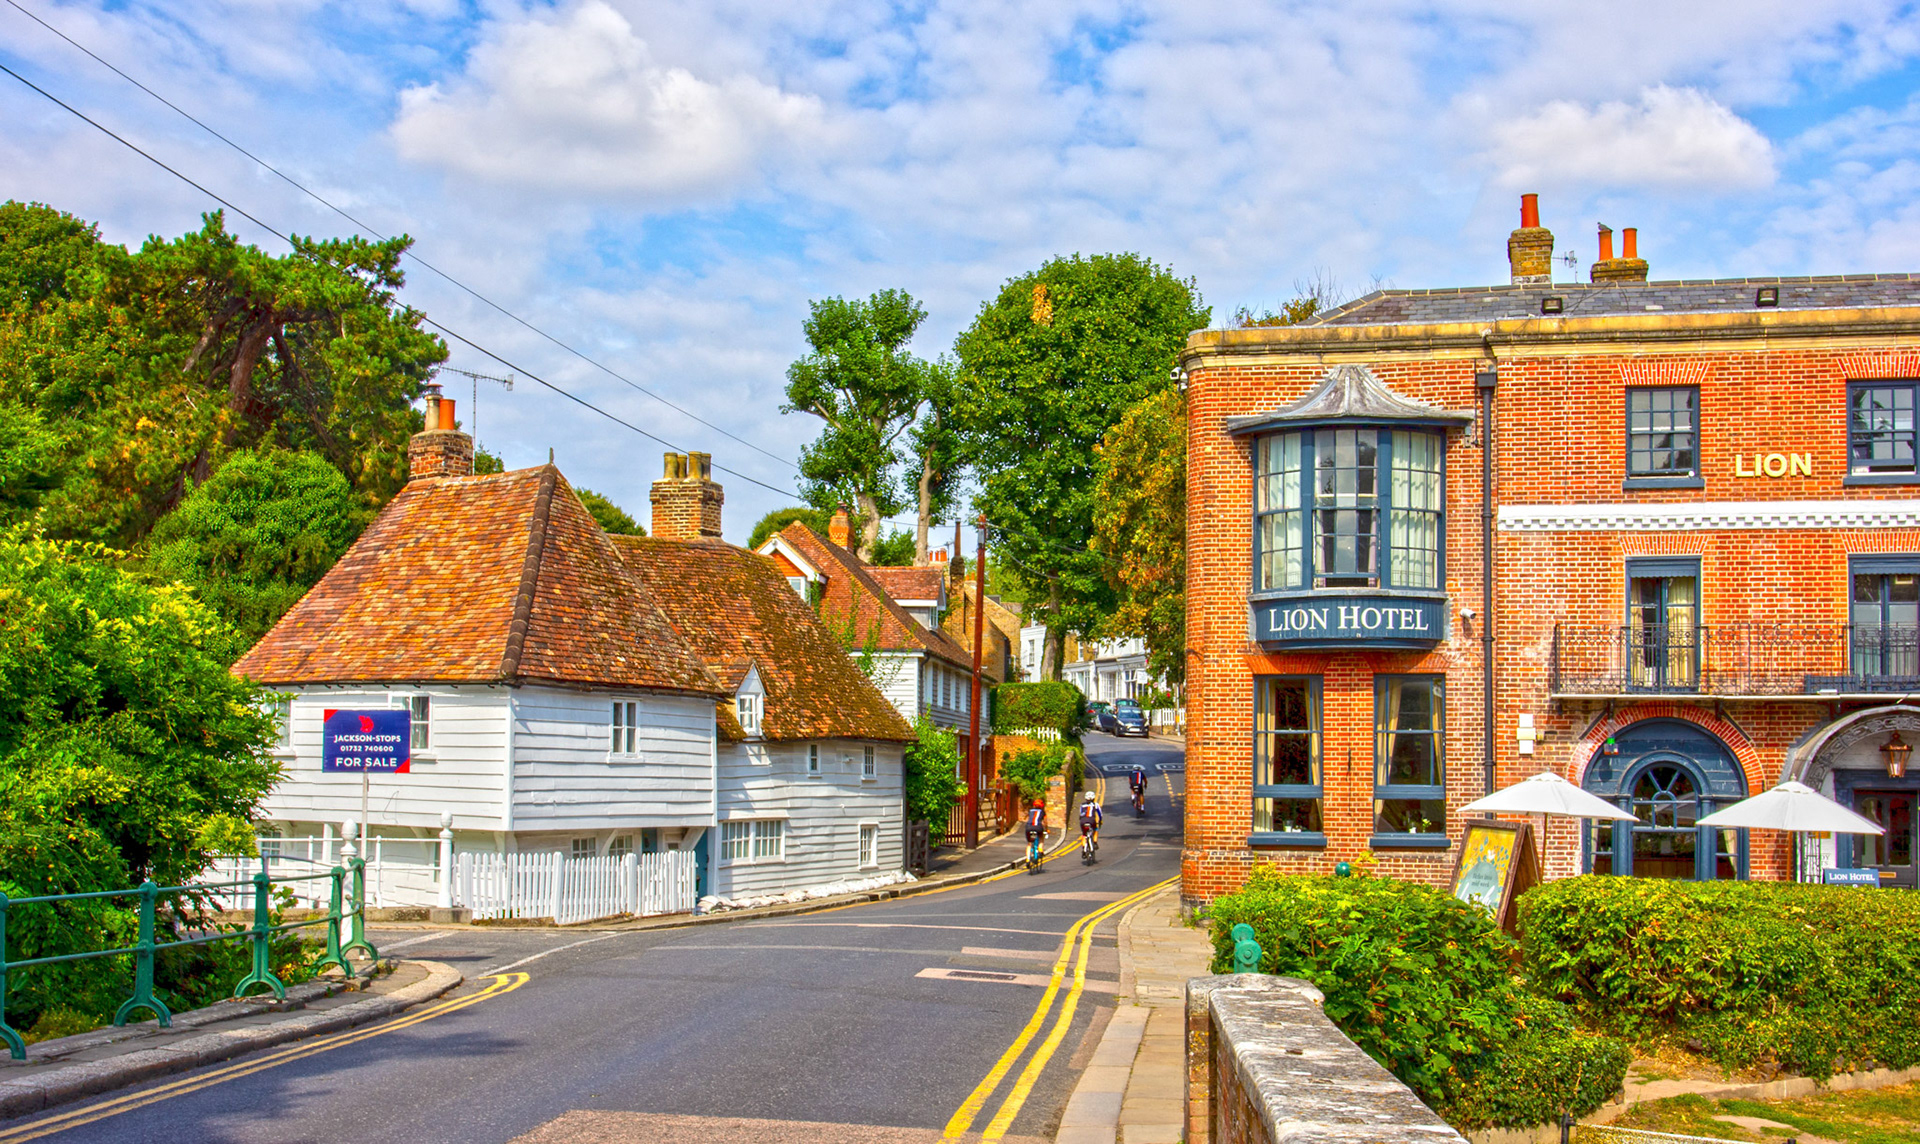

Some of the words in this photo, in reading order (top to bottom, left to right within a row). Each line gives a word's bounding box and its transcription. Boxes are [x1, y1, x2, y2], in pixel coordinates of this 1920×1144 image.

[1735, 453, 1812, 478] LION
[1269, 608, 1329, 632] LION
[1337, 606, 1429, 631] HOTEL
[333, 735, 402, 743] JACKSON-STOPS
[336, 757, 361, 767] FOR
[365, 757, 397, 767] SALE
[1829, 873, 1847, 881] LION
[1849, 873, 1875, 881] HOTEL
